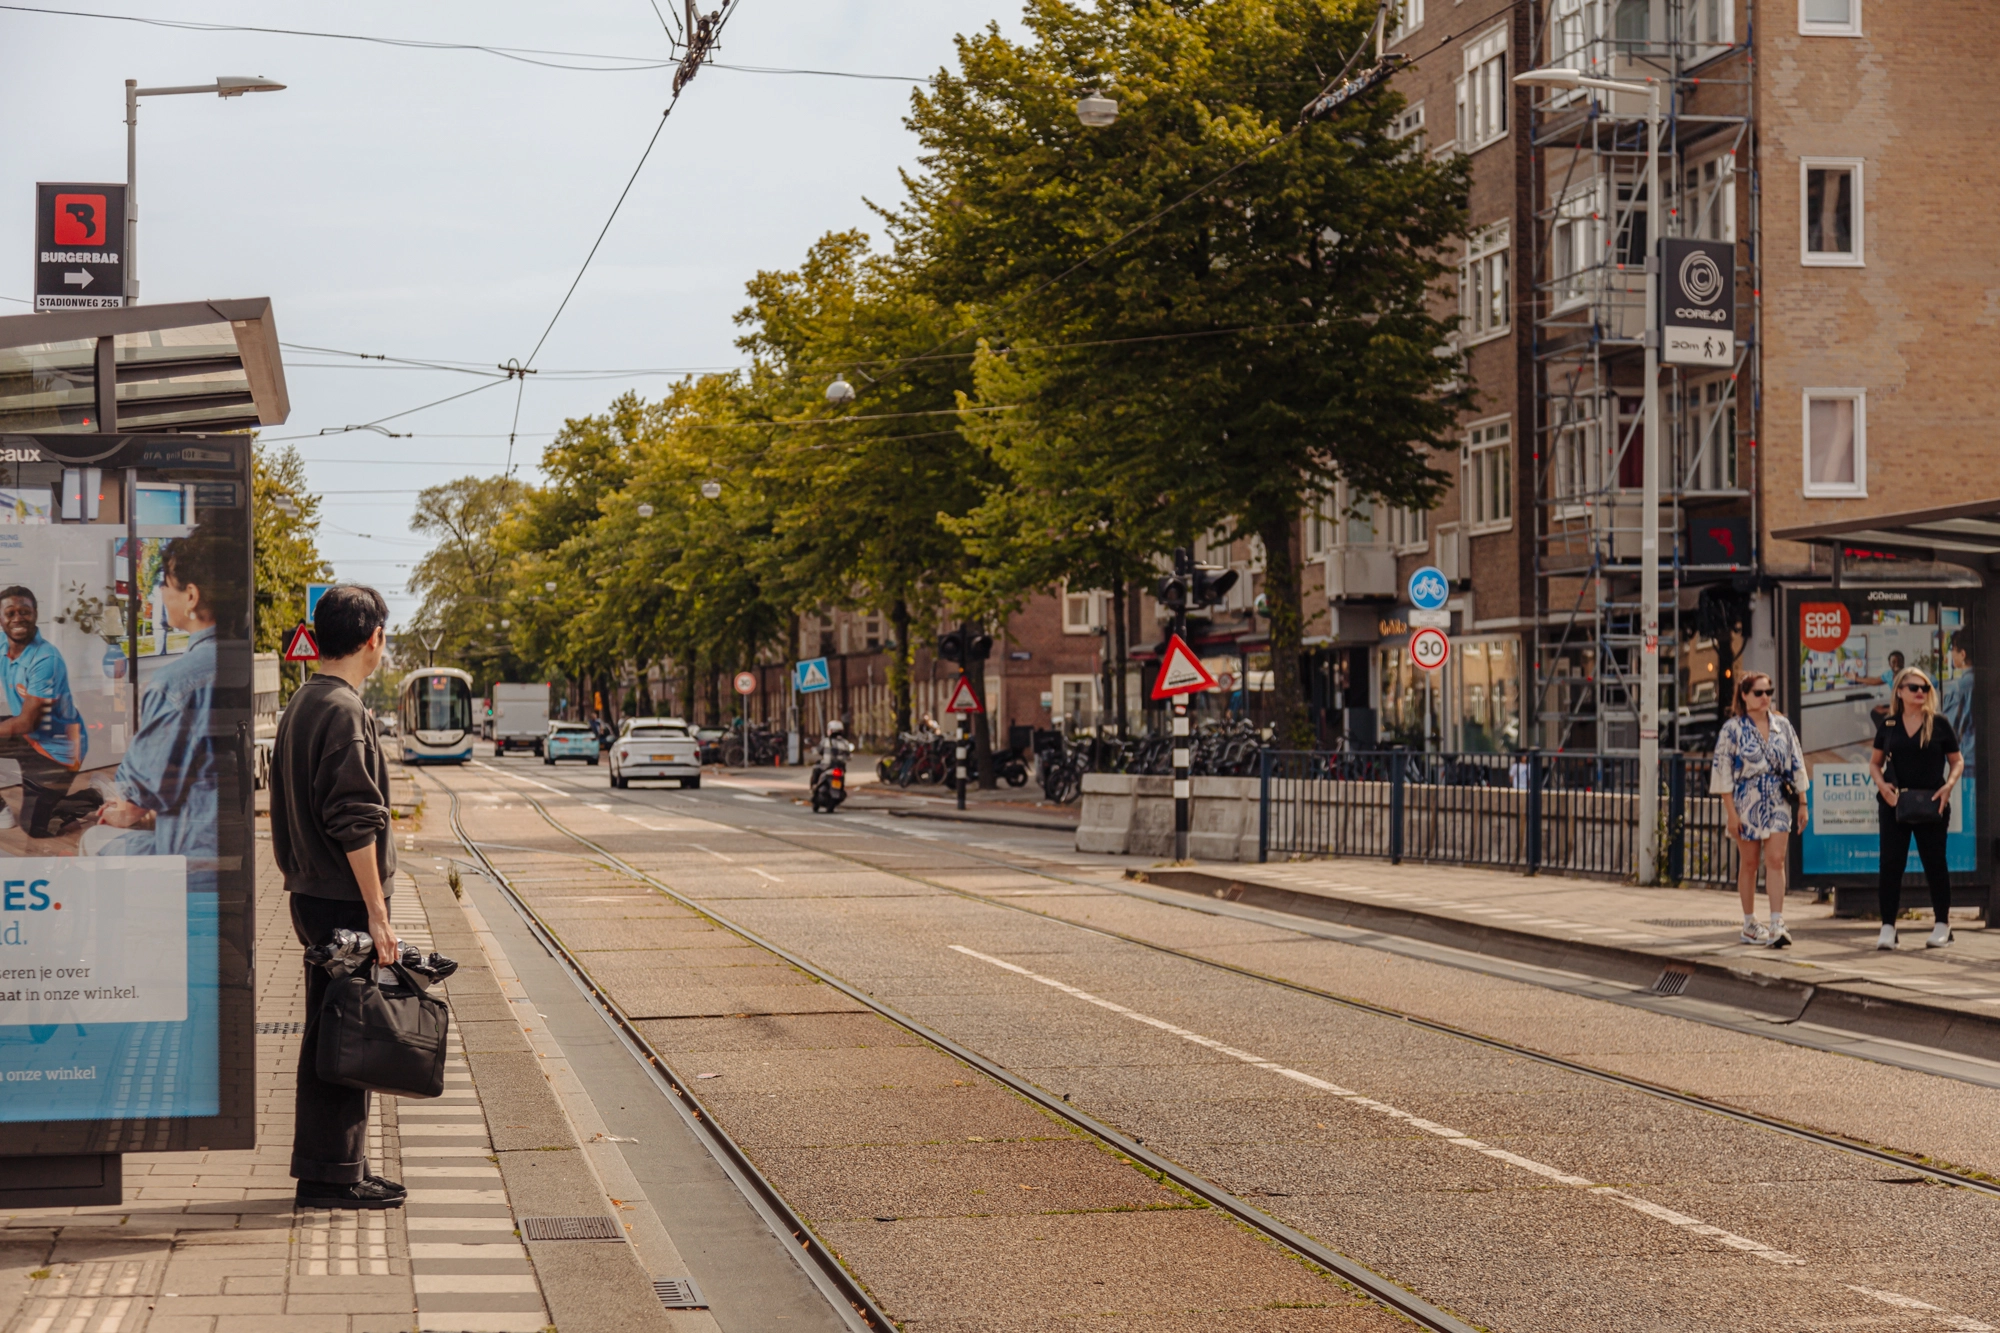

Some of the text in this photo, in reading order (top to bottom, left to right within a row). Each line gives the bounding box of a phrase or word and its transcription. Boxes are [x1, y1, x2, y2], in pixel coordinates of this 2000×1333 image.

[41, 251, 119, 264] BURGERBAR
[39, 298, 119, 308] STADIONWEG 255
[1805, 609, 1841, 624] cool
[1805, 624, 1841, 638] blue
[1418, 640, 1443, 657] 30
[1823, 789, 1851, 802] Goed
[0, 965, 90, 982] eren je over
[25, 987, 40, 1001] in
[43, 988, 80, 1001] onze
[83, 985, 140, 999] winkel.
[6, 1068, 42, 1082] onze
[46, 1065, 96, 1081] winkel
